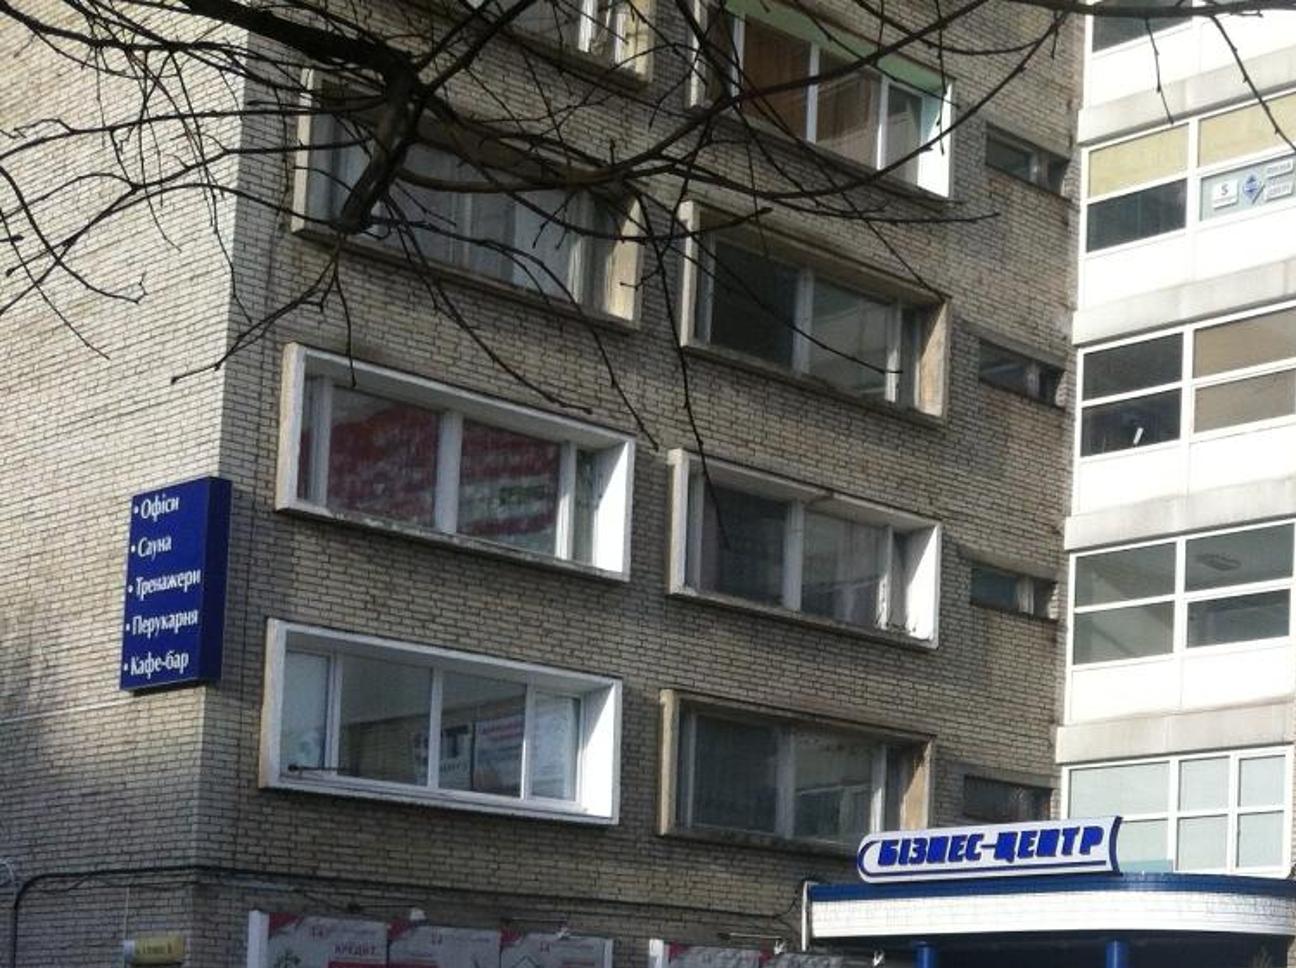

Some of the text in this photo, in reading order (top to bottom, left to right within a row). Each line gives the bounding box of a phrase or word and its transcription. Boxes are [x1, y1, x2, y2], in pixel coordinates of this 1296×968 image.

[141, 494, 179, 522] Офіси
[137, 536, 171, 562] Сауна
[136, 569, 201, 600] Тренажери
[132, 609, 198, 638] Перукарня
[131, 651, 189, 678] Кафе-бар
[876, 825, 1105, 867] БІЗНЕС-ЦЕНТР
